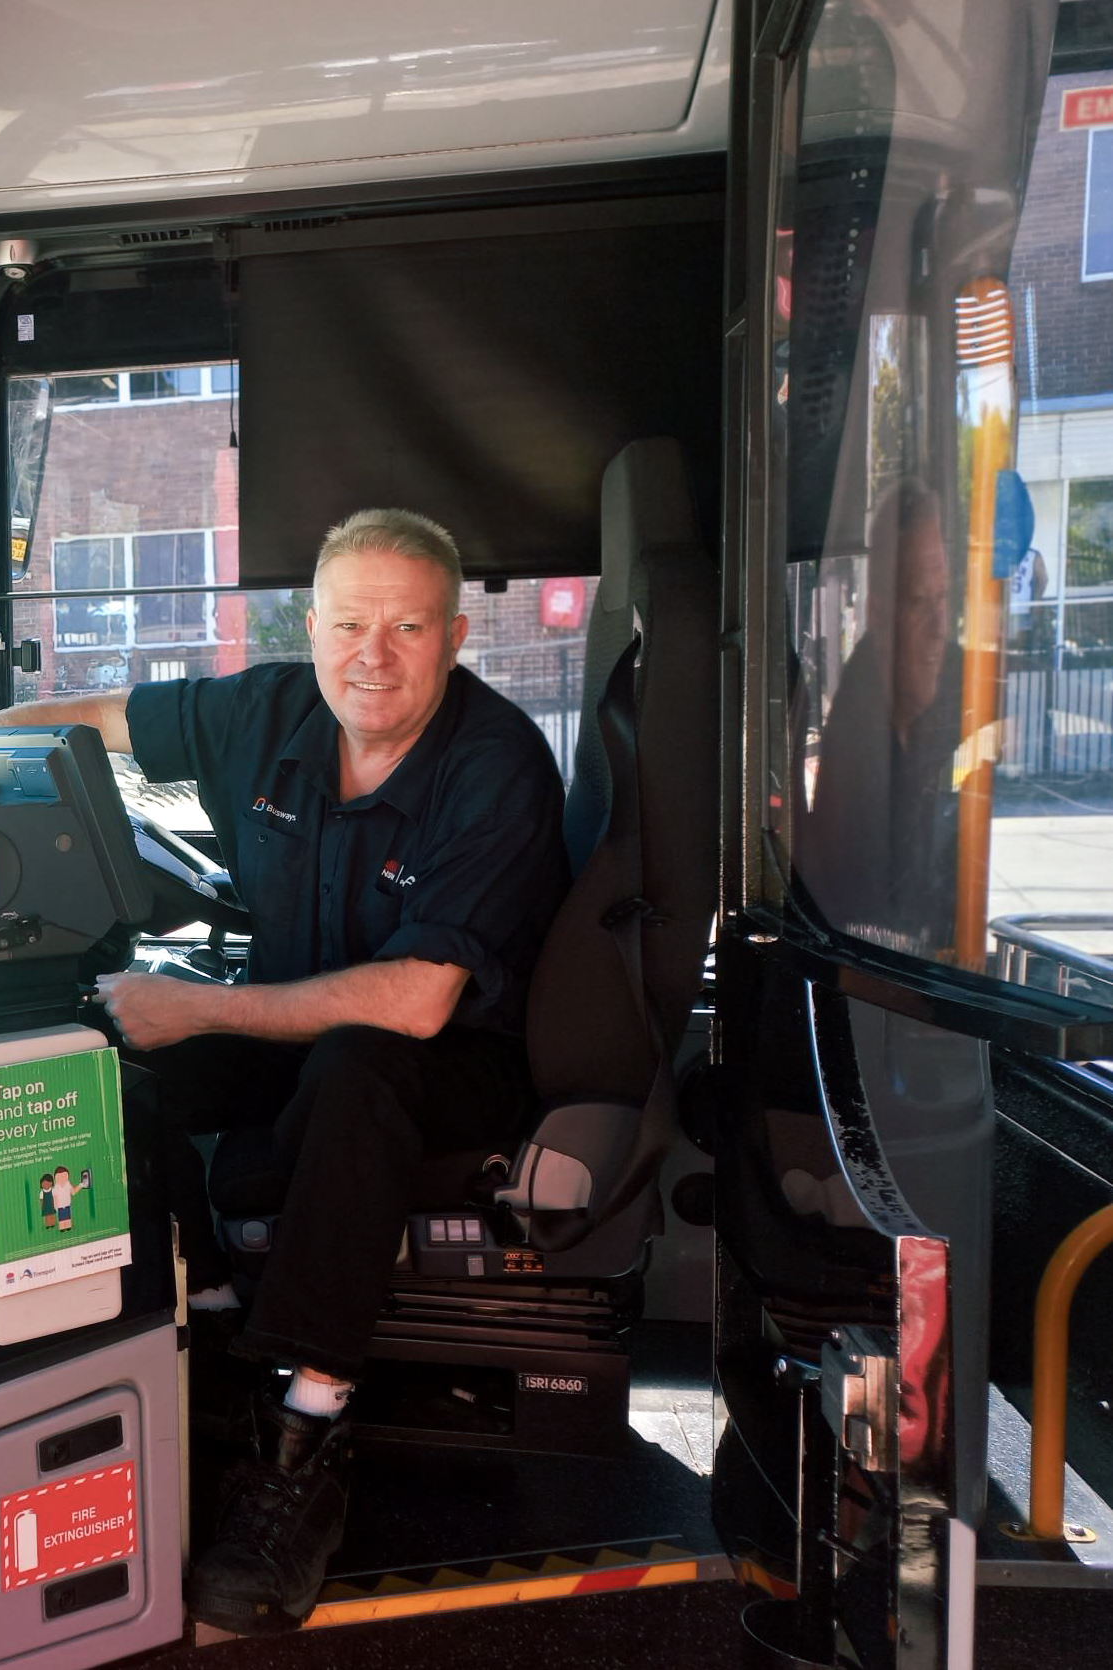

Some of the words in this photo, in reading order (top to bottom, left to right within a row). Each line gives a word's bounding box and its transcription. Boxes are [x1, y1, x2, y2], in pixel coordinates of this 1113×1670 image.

[266, 804, 297, 822] Busways
[25, 1081, 45, 1095] on
[27, 1099, 53, 1115] tap
[56, 1091, 78, 1110] off
[42, 1114, 76, 1132] time
[526, 1376, 549, 1389] ISRI
[550, 1378, 582, 1392] 6860
[71, 1506, 97, 1523] FIRE
[44, 1515, 125, 1549] EXTINGUISHER
